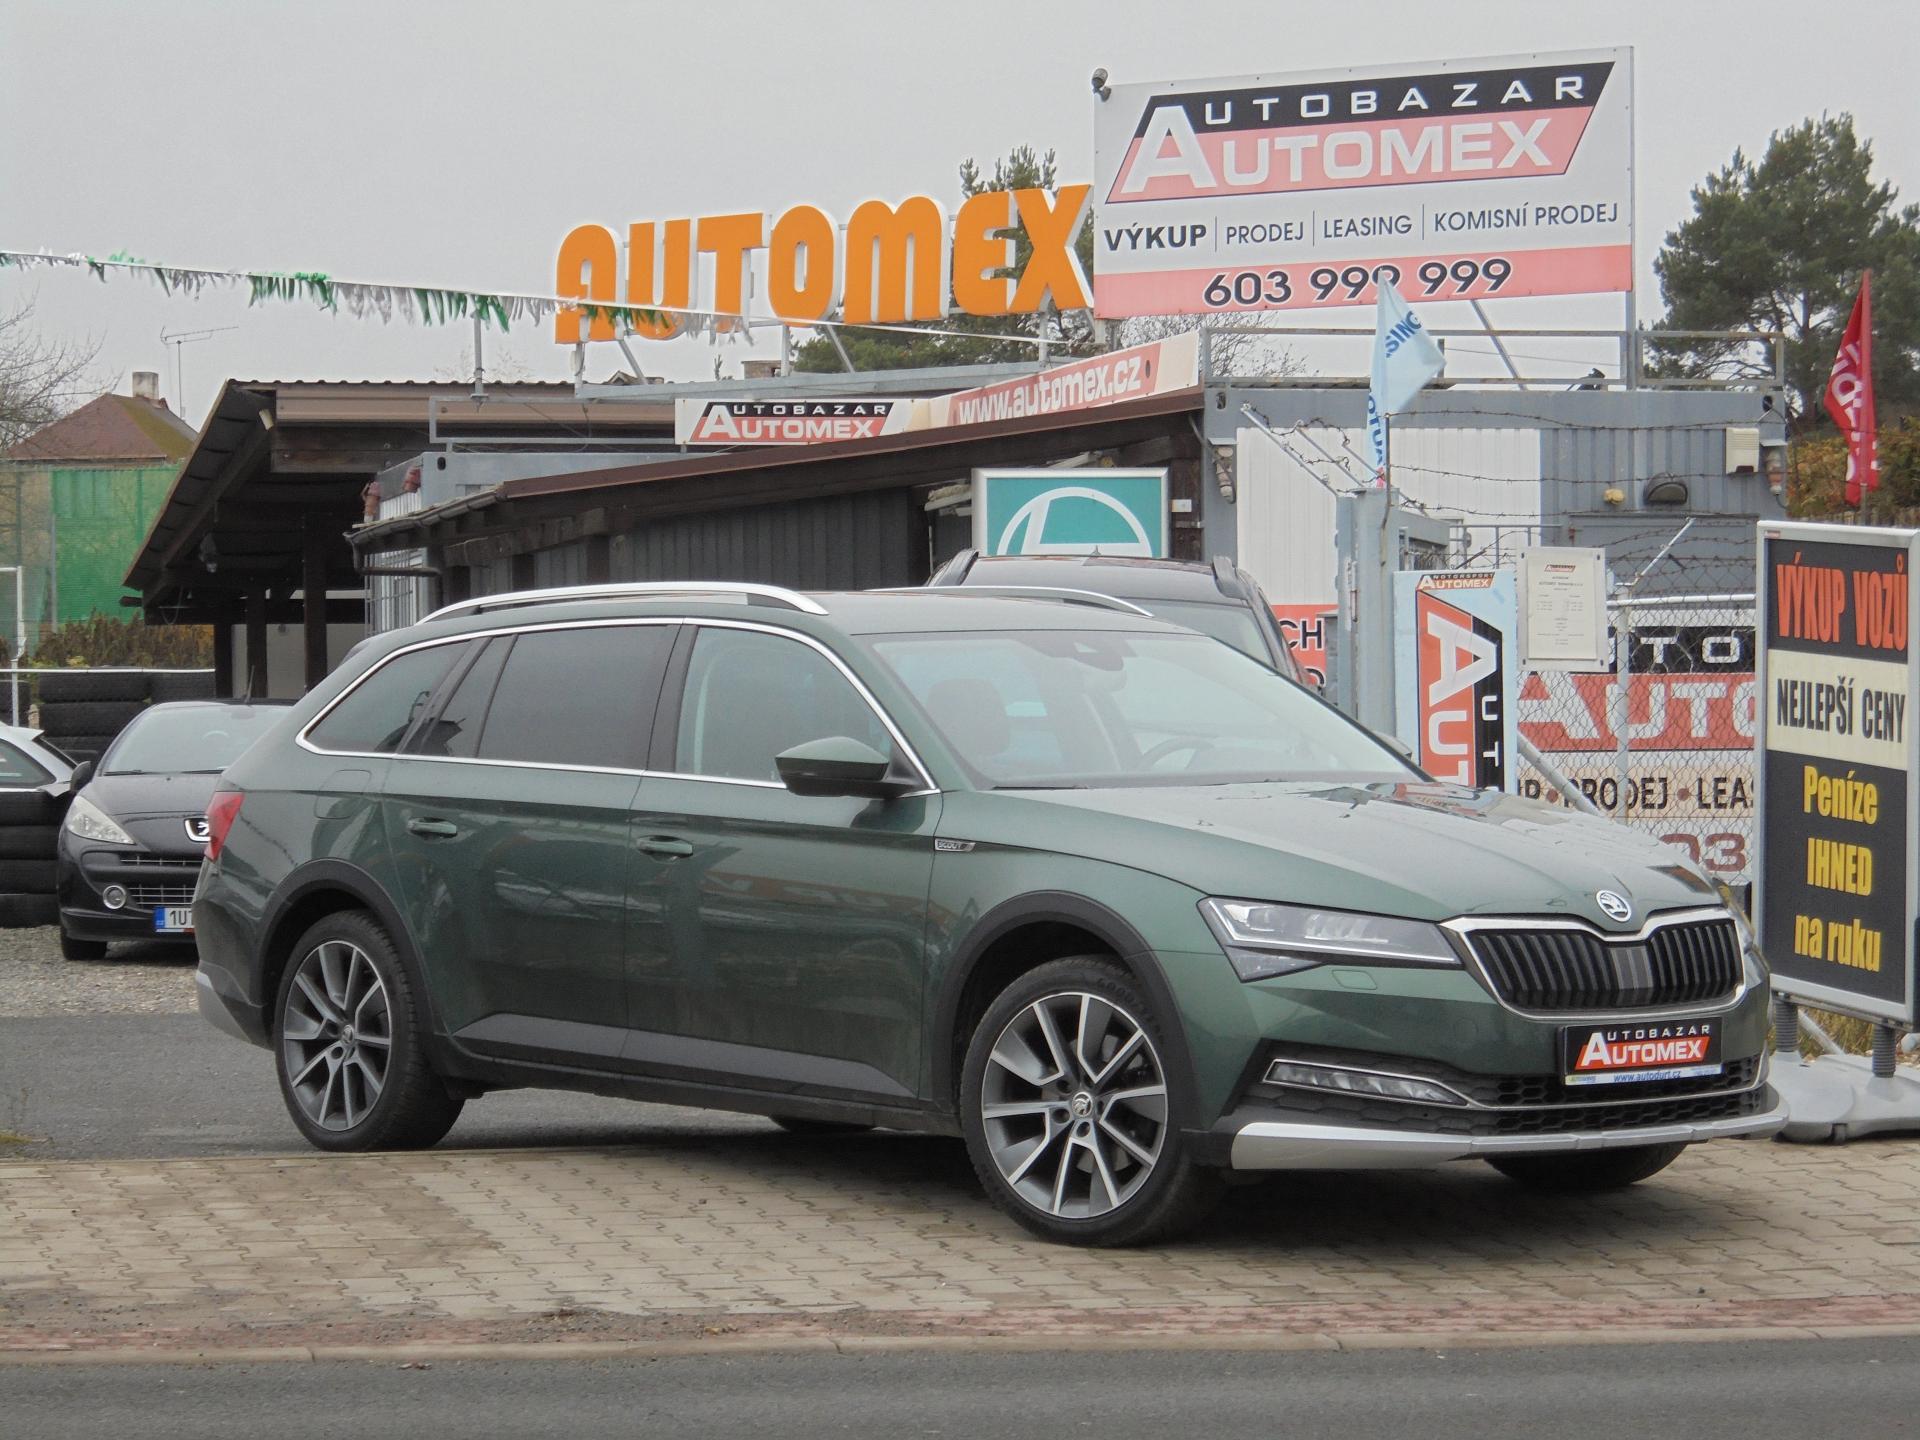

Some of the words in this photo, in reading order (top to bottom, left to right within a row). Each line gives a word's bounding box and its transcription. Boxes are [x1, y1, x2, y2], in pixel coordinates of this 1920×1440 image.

[1120, 104, 1552, 194] AUTOMEX
[1103, 221, 1207, 252] VÝKUP
[1226, 221, 1305, 245] PRODEJ
[1322, 214, 1413, 239] LEASING
[1433, 201, 1530, 233] KOMISNÍ
[1535, 202, 1619, 227] PRODEJ
[555, 184, 1093, 345] AUTOMEX
[1203, 269, 1293, 307] 603
[1309, 264, 1401, 301] 999
[1417, 257, 1513, 296] 999
[958, 355, 1142, 426] www.automex.cz
[698, 404, 875, 439] AUTOMEX
[1417, 574, 1489, 590] AUTOMEX
[1775, 551, 1846, 644] VÝKUP
[1852, 552, 1908, 652] VOZŮ
[1776, 674, 1855, 736] NEJLEPŠÍ
[1861, 688, 1907, 744] CENY
[1803, 765, 1878, 825] Peníze
[1806, 837, 1873, 897] IHNED
[170, 910, 192, 926] 1U
[1794, 913, 1823, 960] na
[1826, 918, 1881, 973] ruku
[1580, 1032, 1703, 1067] AUTOMEX
